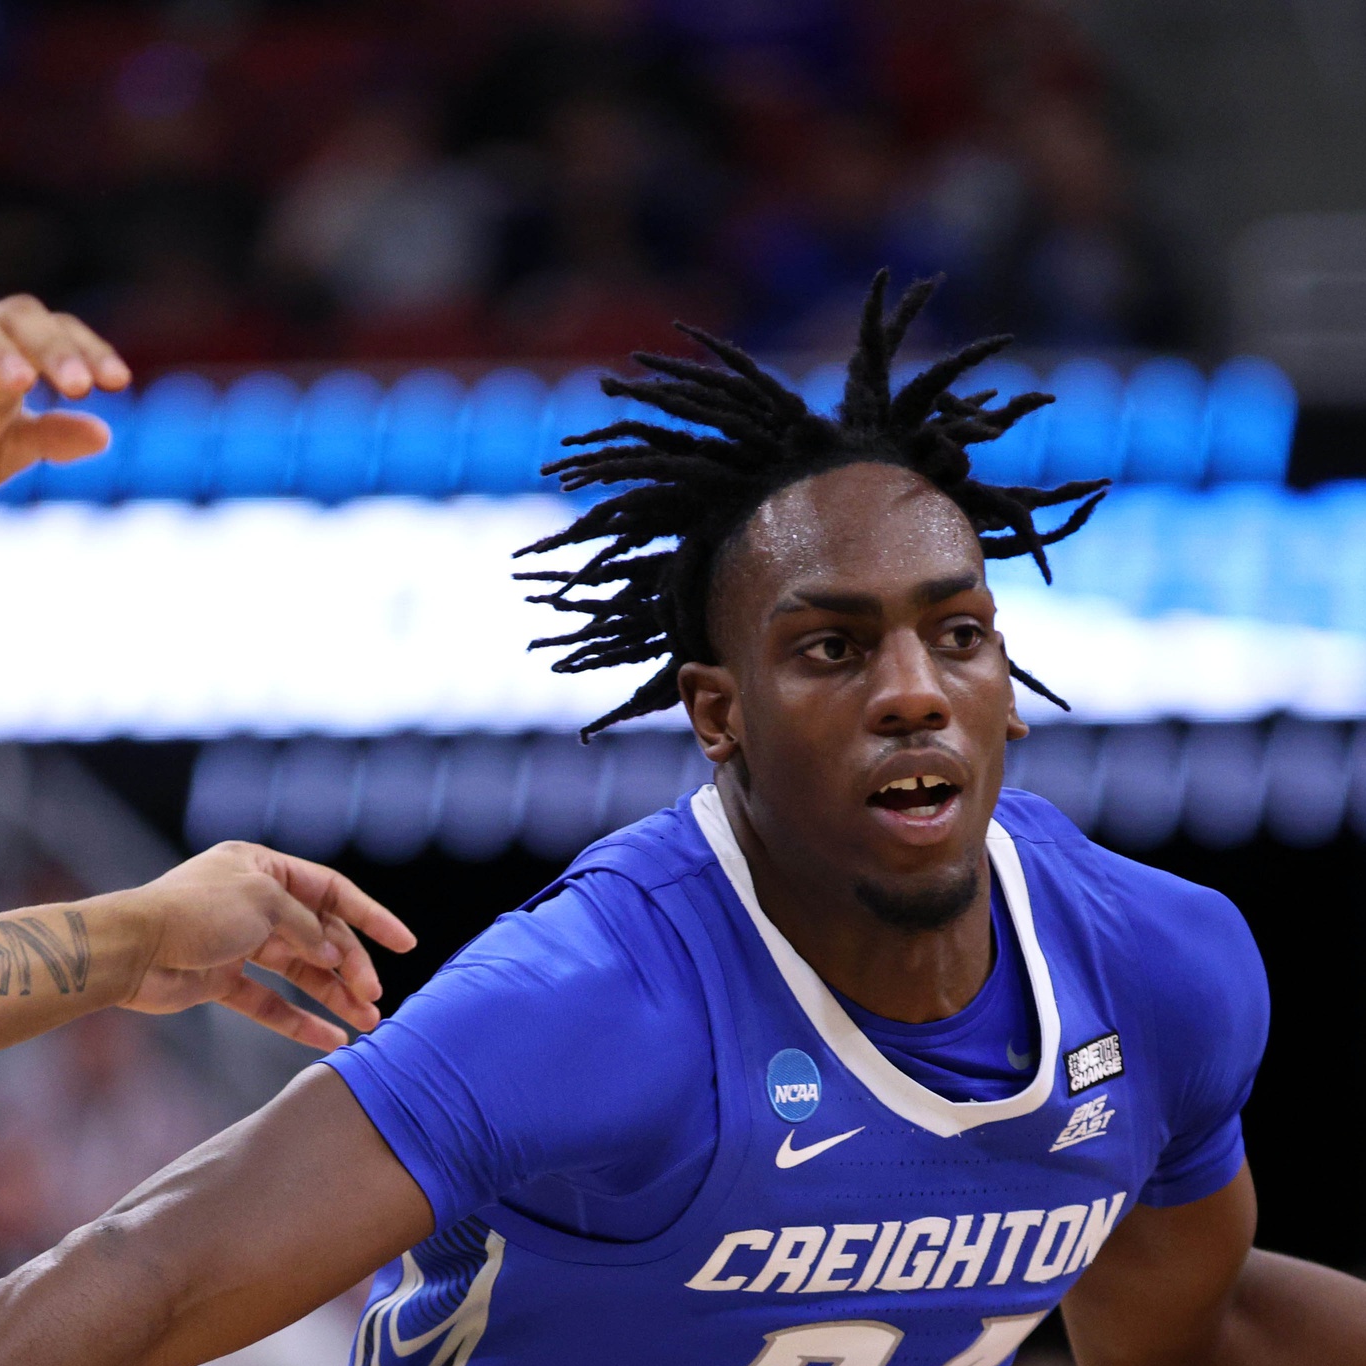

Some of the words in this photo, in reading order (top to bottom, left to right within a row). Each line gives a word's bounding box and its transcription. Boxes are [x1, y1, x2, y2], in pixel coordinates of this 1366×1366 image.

[1070, 1056, 1123, 1092] CHANGE
[775, 1083, 819, 1104] NCAA
[1067, 1093, 1108, 1127] BIG
[1055, 1109, 1115, 1144] EAST
[684, 1191, 1127, 1294] CREIGHTON
